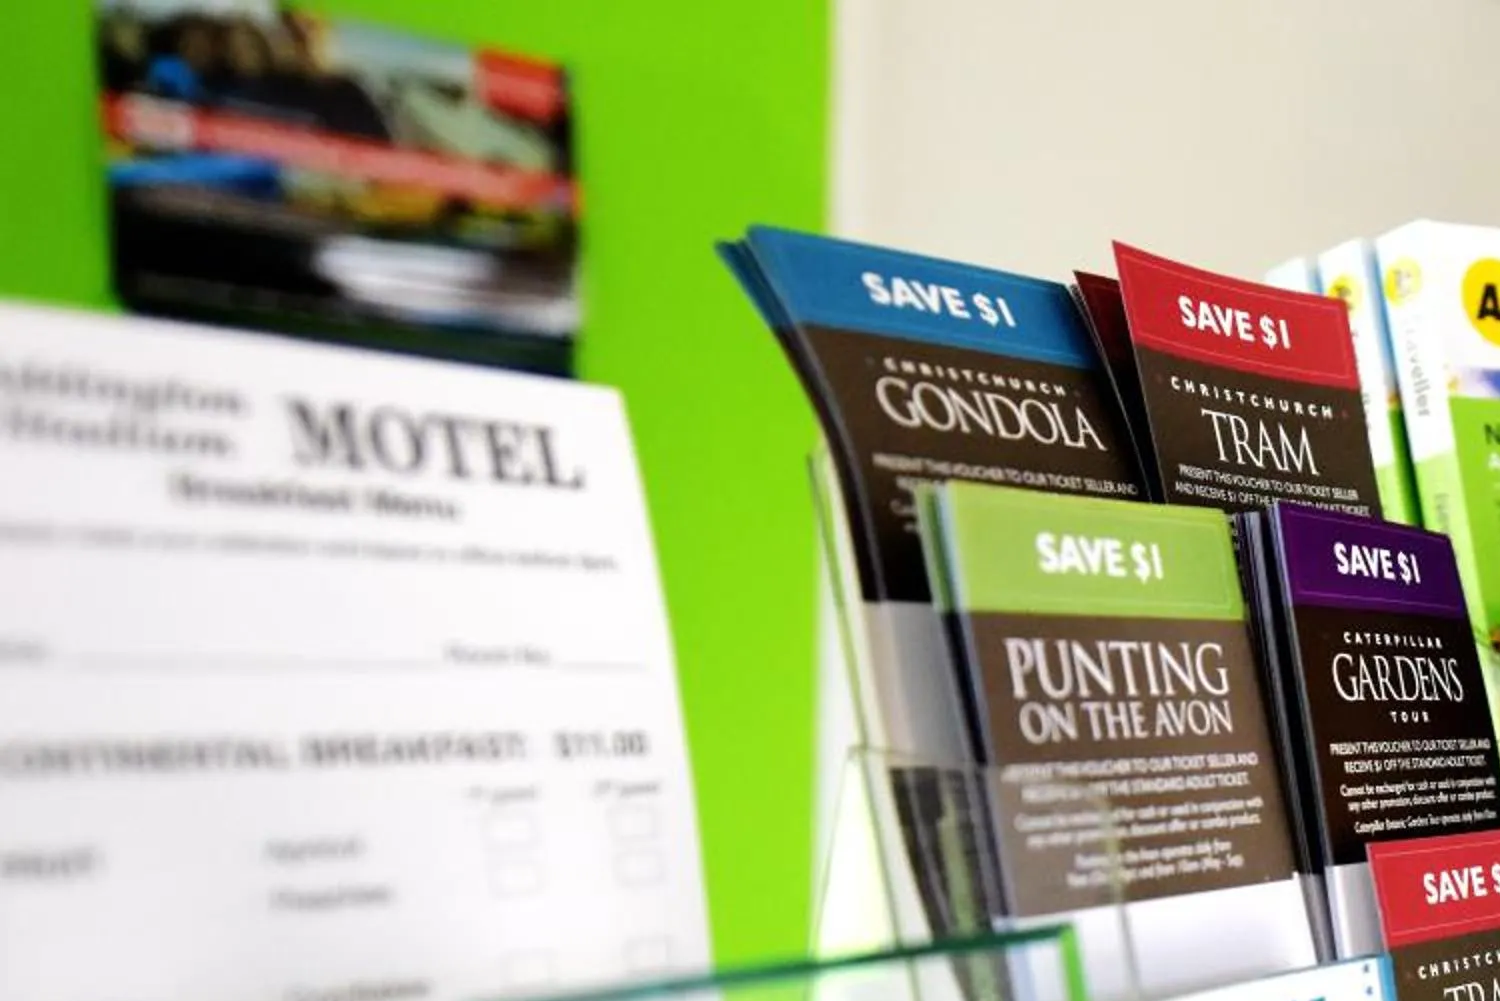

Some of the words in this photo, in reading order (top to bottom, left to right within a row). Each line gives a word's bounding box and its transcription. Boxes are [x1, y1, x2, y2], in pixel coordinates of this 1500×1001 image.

[861, 272, 971, 320] SAVE
[974, 294, 1017, 328] $1
[1178, 295, 1255, 342] SAVE
[1259, 314, 1292, 350] $1
[883, 356, 1068, 397] CHRISTCHURCH
[1170, 375, 1334, 419] CHRISTCHURCH
[875, 375, 1108, 452] GONDOLA
[285, 394, 585, 490] MOTEL
[1201, 408, 1321, 477] TRAM
[1050, 474, 1082, 490] TICKET
[1035, 533, 1127, 577] SAVE
[1131, 544, 1164, 583] $1
[1333, 542, 1395, 581] SAVE
[1397, 551, 1421, 585] $1
[1344, 631, 1443, 650] CATERPILLAR
[1005, 638, 1229, 698] PUNTING
[1332, 653, 1464, 703] GARDENS
[1019, 701, 1078, 744] ON
[1083, 701, 1148, 740] THE
[1155, 700, 1234, 737] AVON
[1390, 710, 1430, 724] TOUR
[1423, 867, 1487, 906] SAVE
